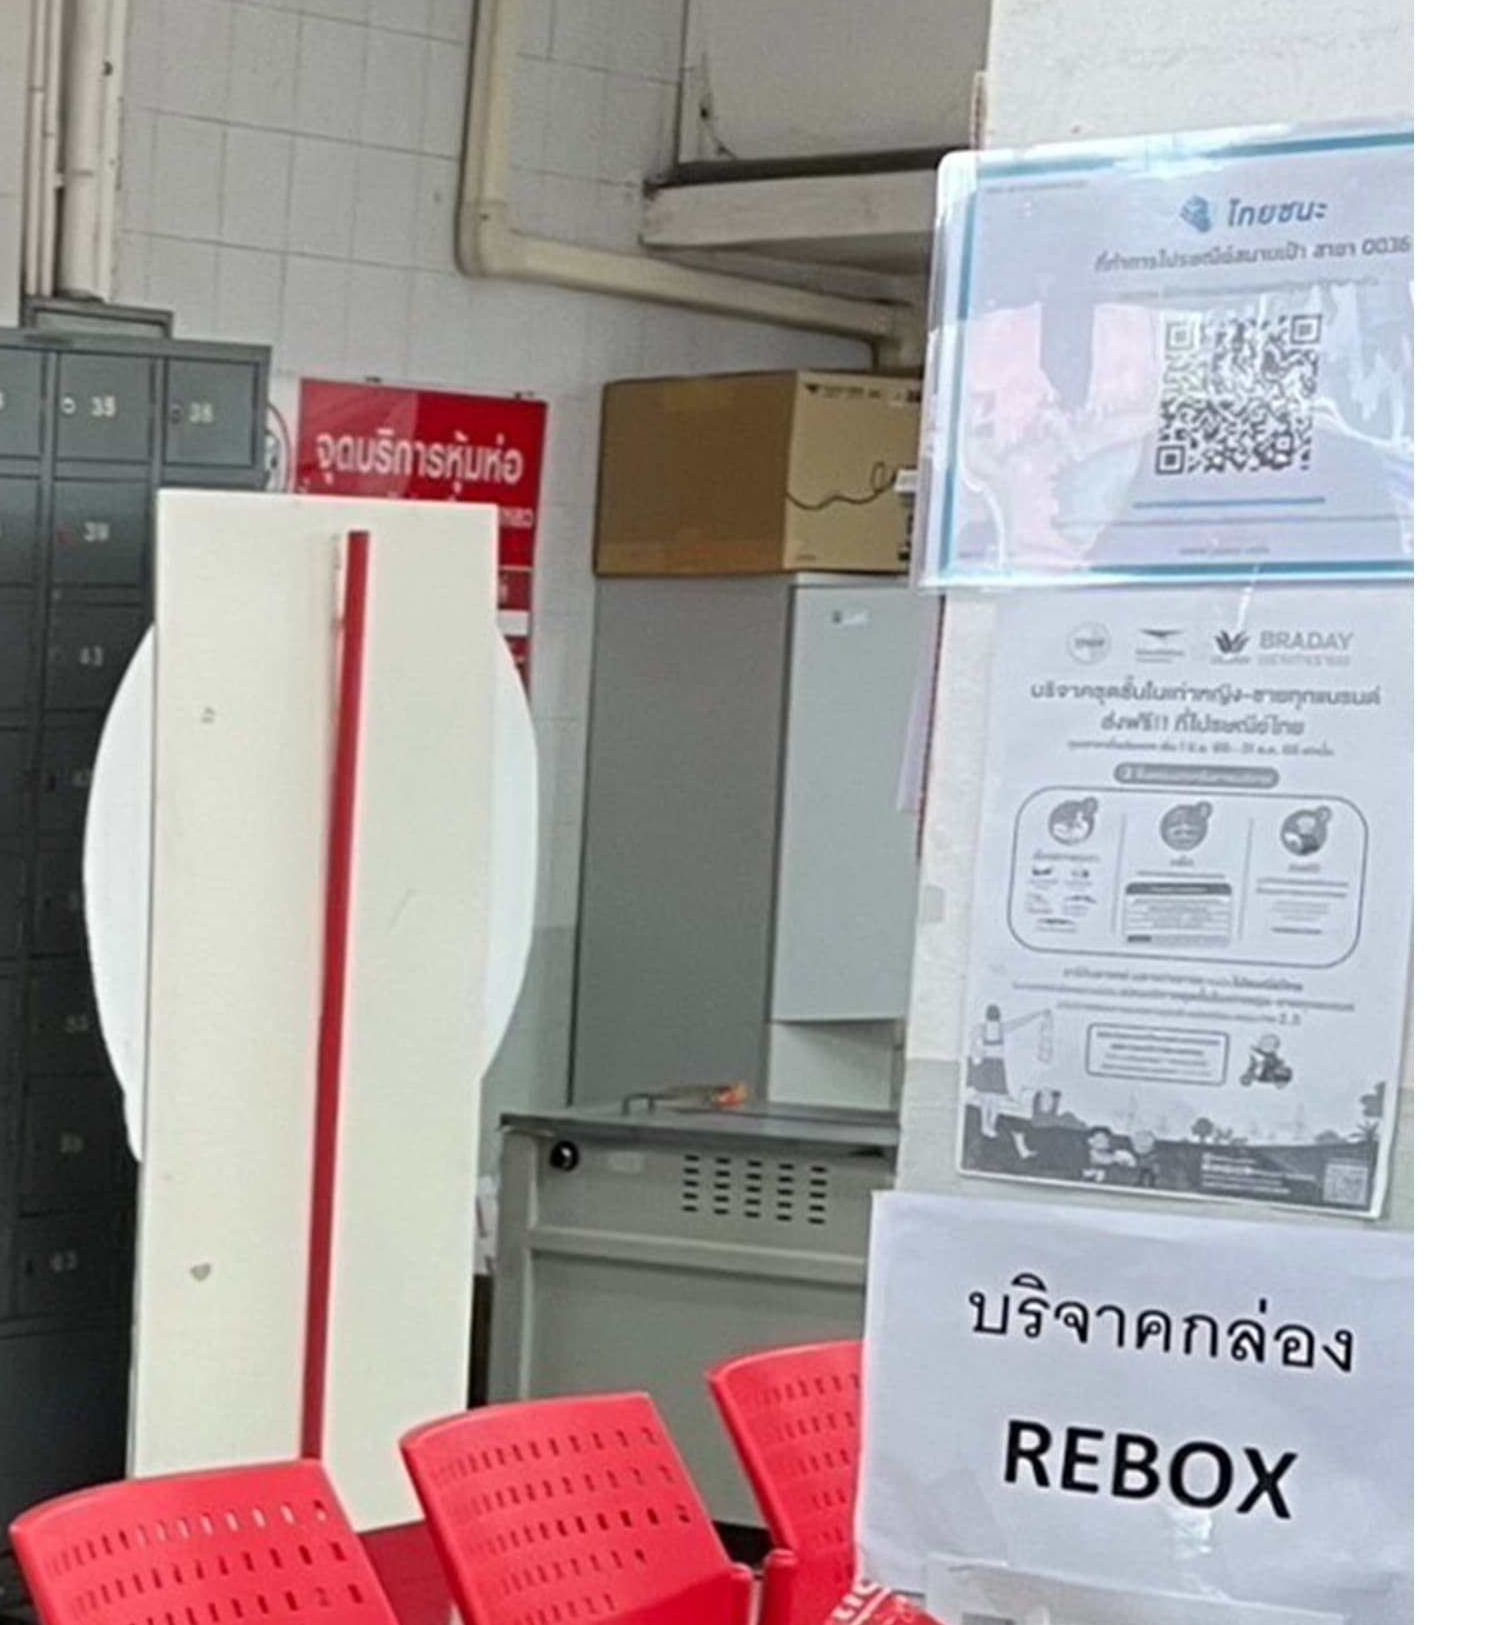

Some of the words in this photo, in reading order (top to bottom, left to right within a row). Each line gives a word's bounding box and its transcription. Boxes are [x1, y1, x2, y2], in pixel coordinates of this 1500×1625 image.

[1226, 197, 1327, 230] ไทยชนะ
[92, 397, 116, 417] 35
[316, 427, 523, 494] จุดบริการหุ้มห่อ
[85, 523, 109, 541] 39
[1258, 630, 1354, 651] BRADAY
[969, 1273, 1353, 1373] บริจาคกล่อง
[1003, 1419, 1298, 1520] REBOX
